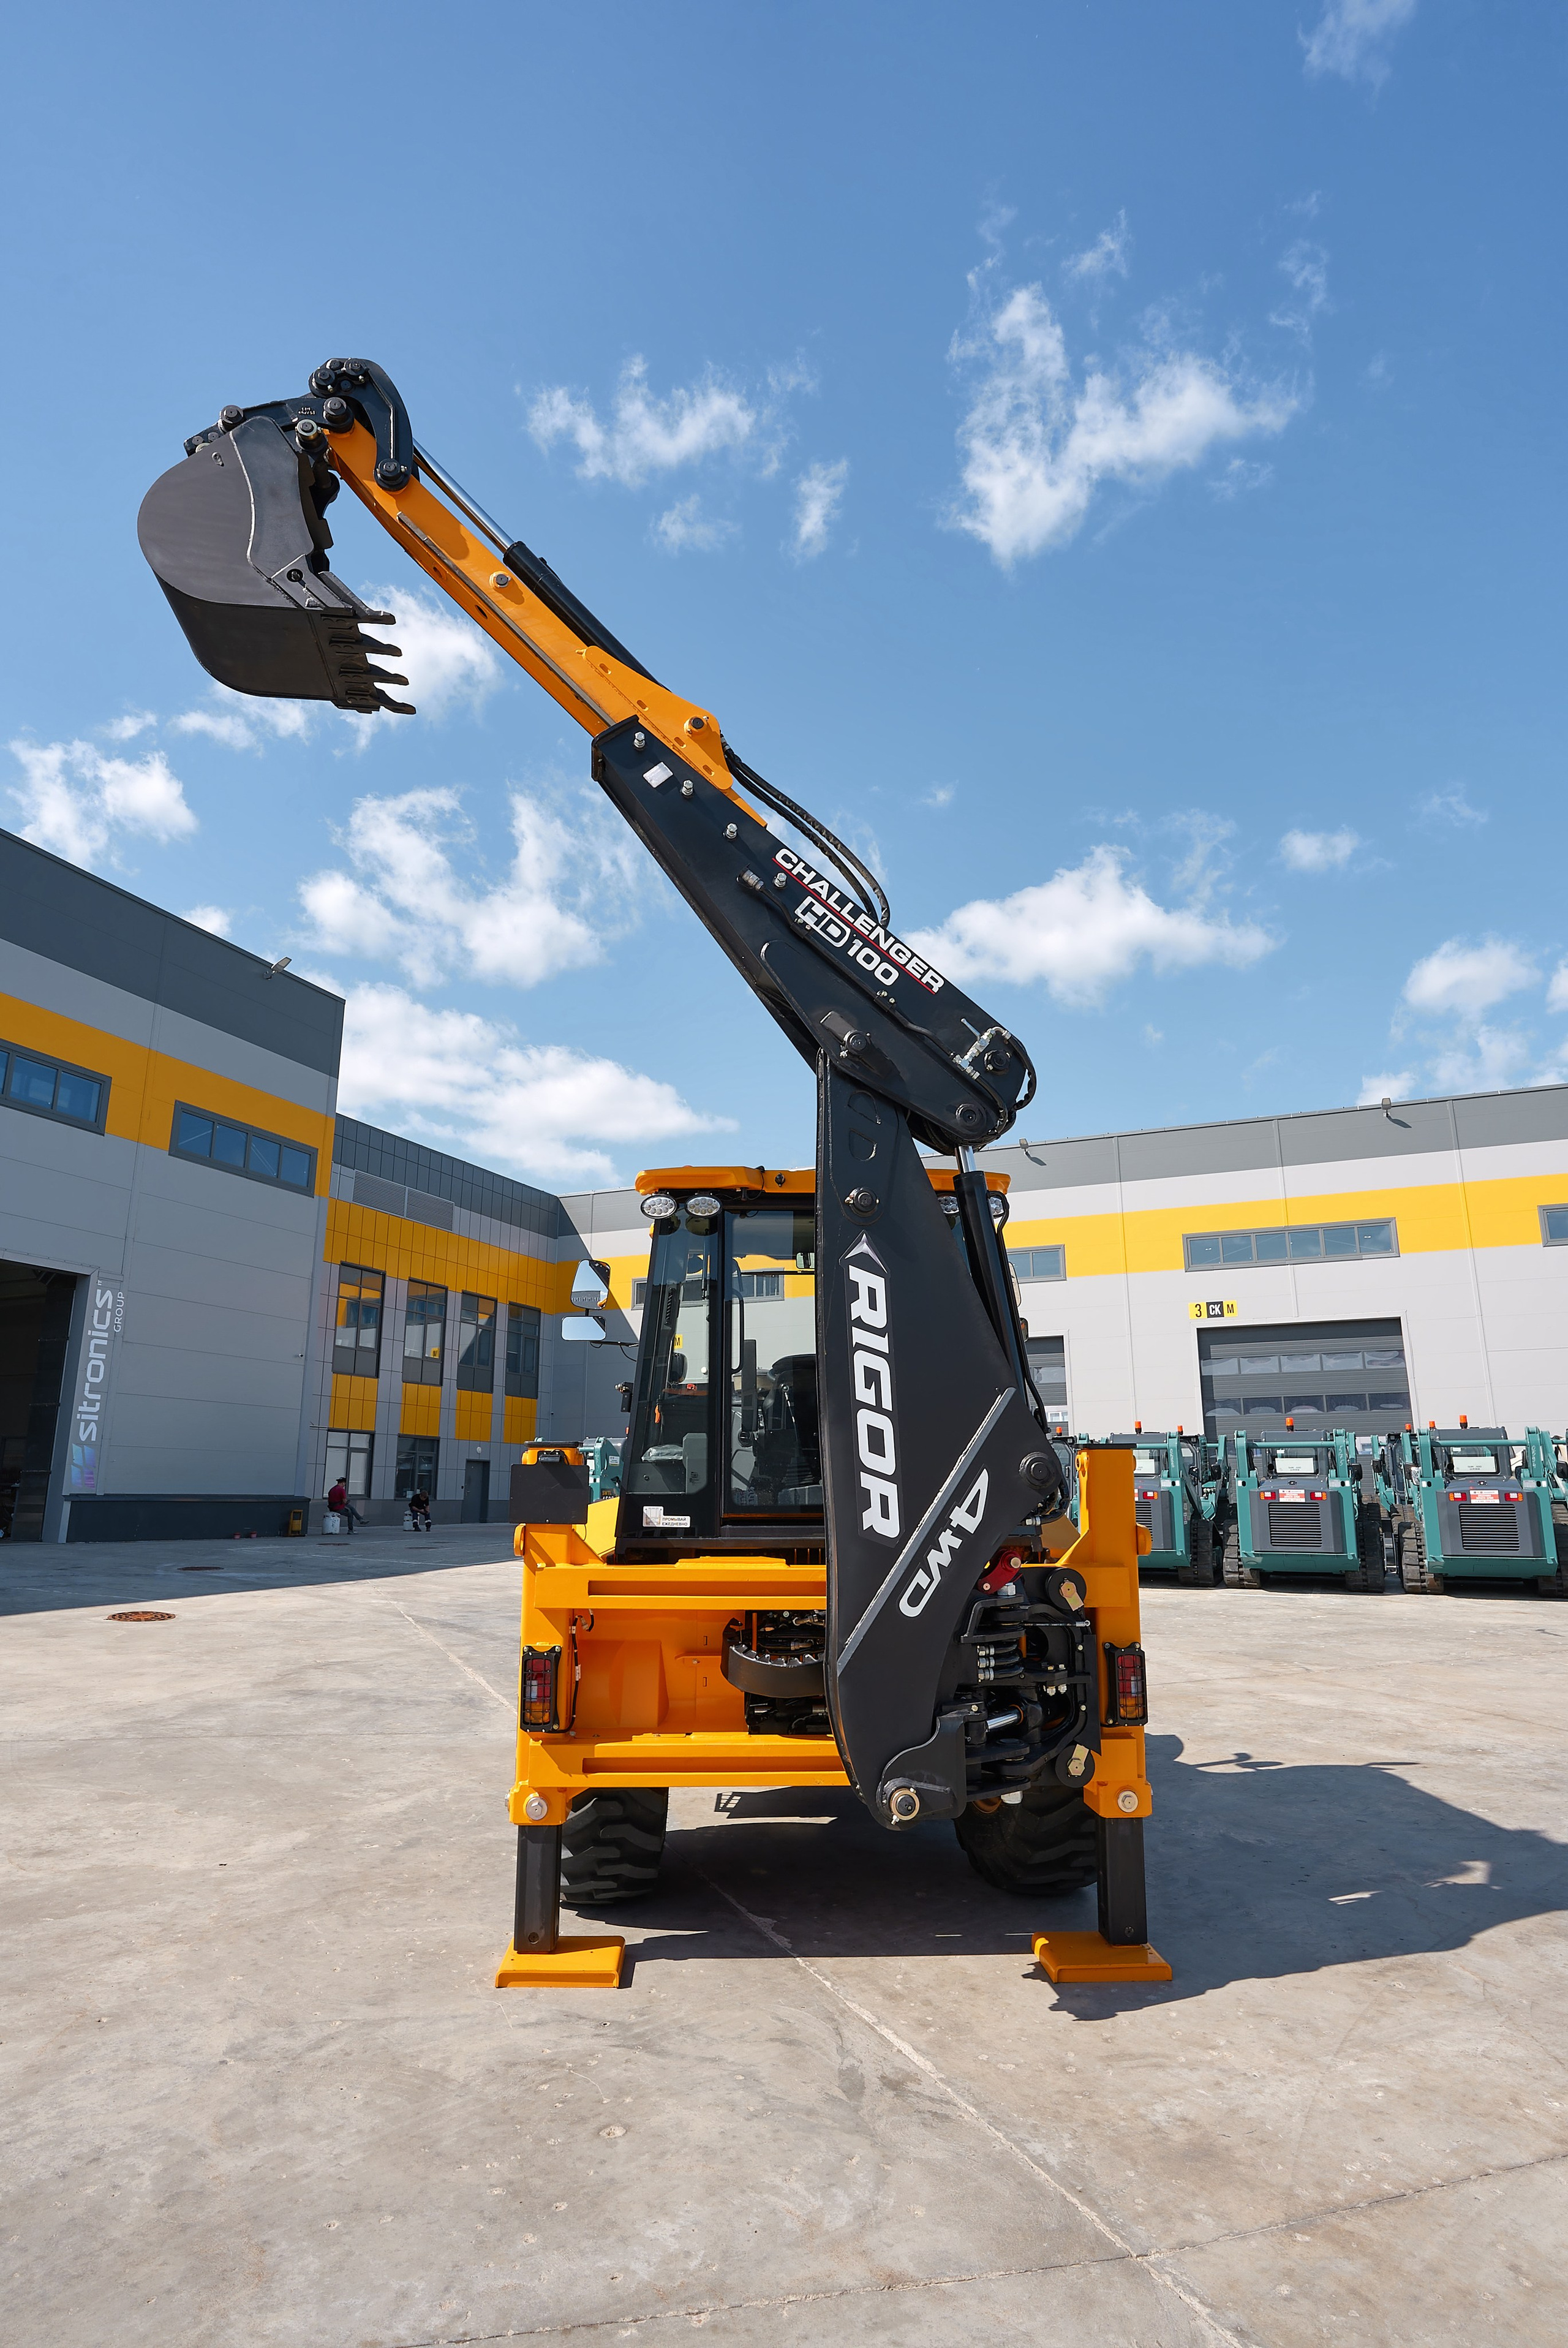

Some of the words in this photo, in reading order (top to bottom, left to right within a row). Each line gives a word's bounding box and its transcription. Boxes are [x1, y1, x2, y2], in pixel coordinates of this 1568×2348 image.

[775, 848, 944, 993] CHALLENGER
[794, 896, 851, 947] HD
[847, 938, 899, 986] 100
[77, 1289, 113, 1441] sitronics
[113, 1291, 124, 1332] GROUP
[1194, 1304, 1202, 1318] 3
[848, 1264, 900, 1539] RIGOR
[899, 1468, 989, 1617] 4WD
